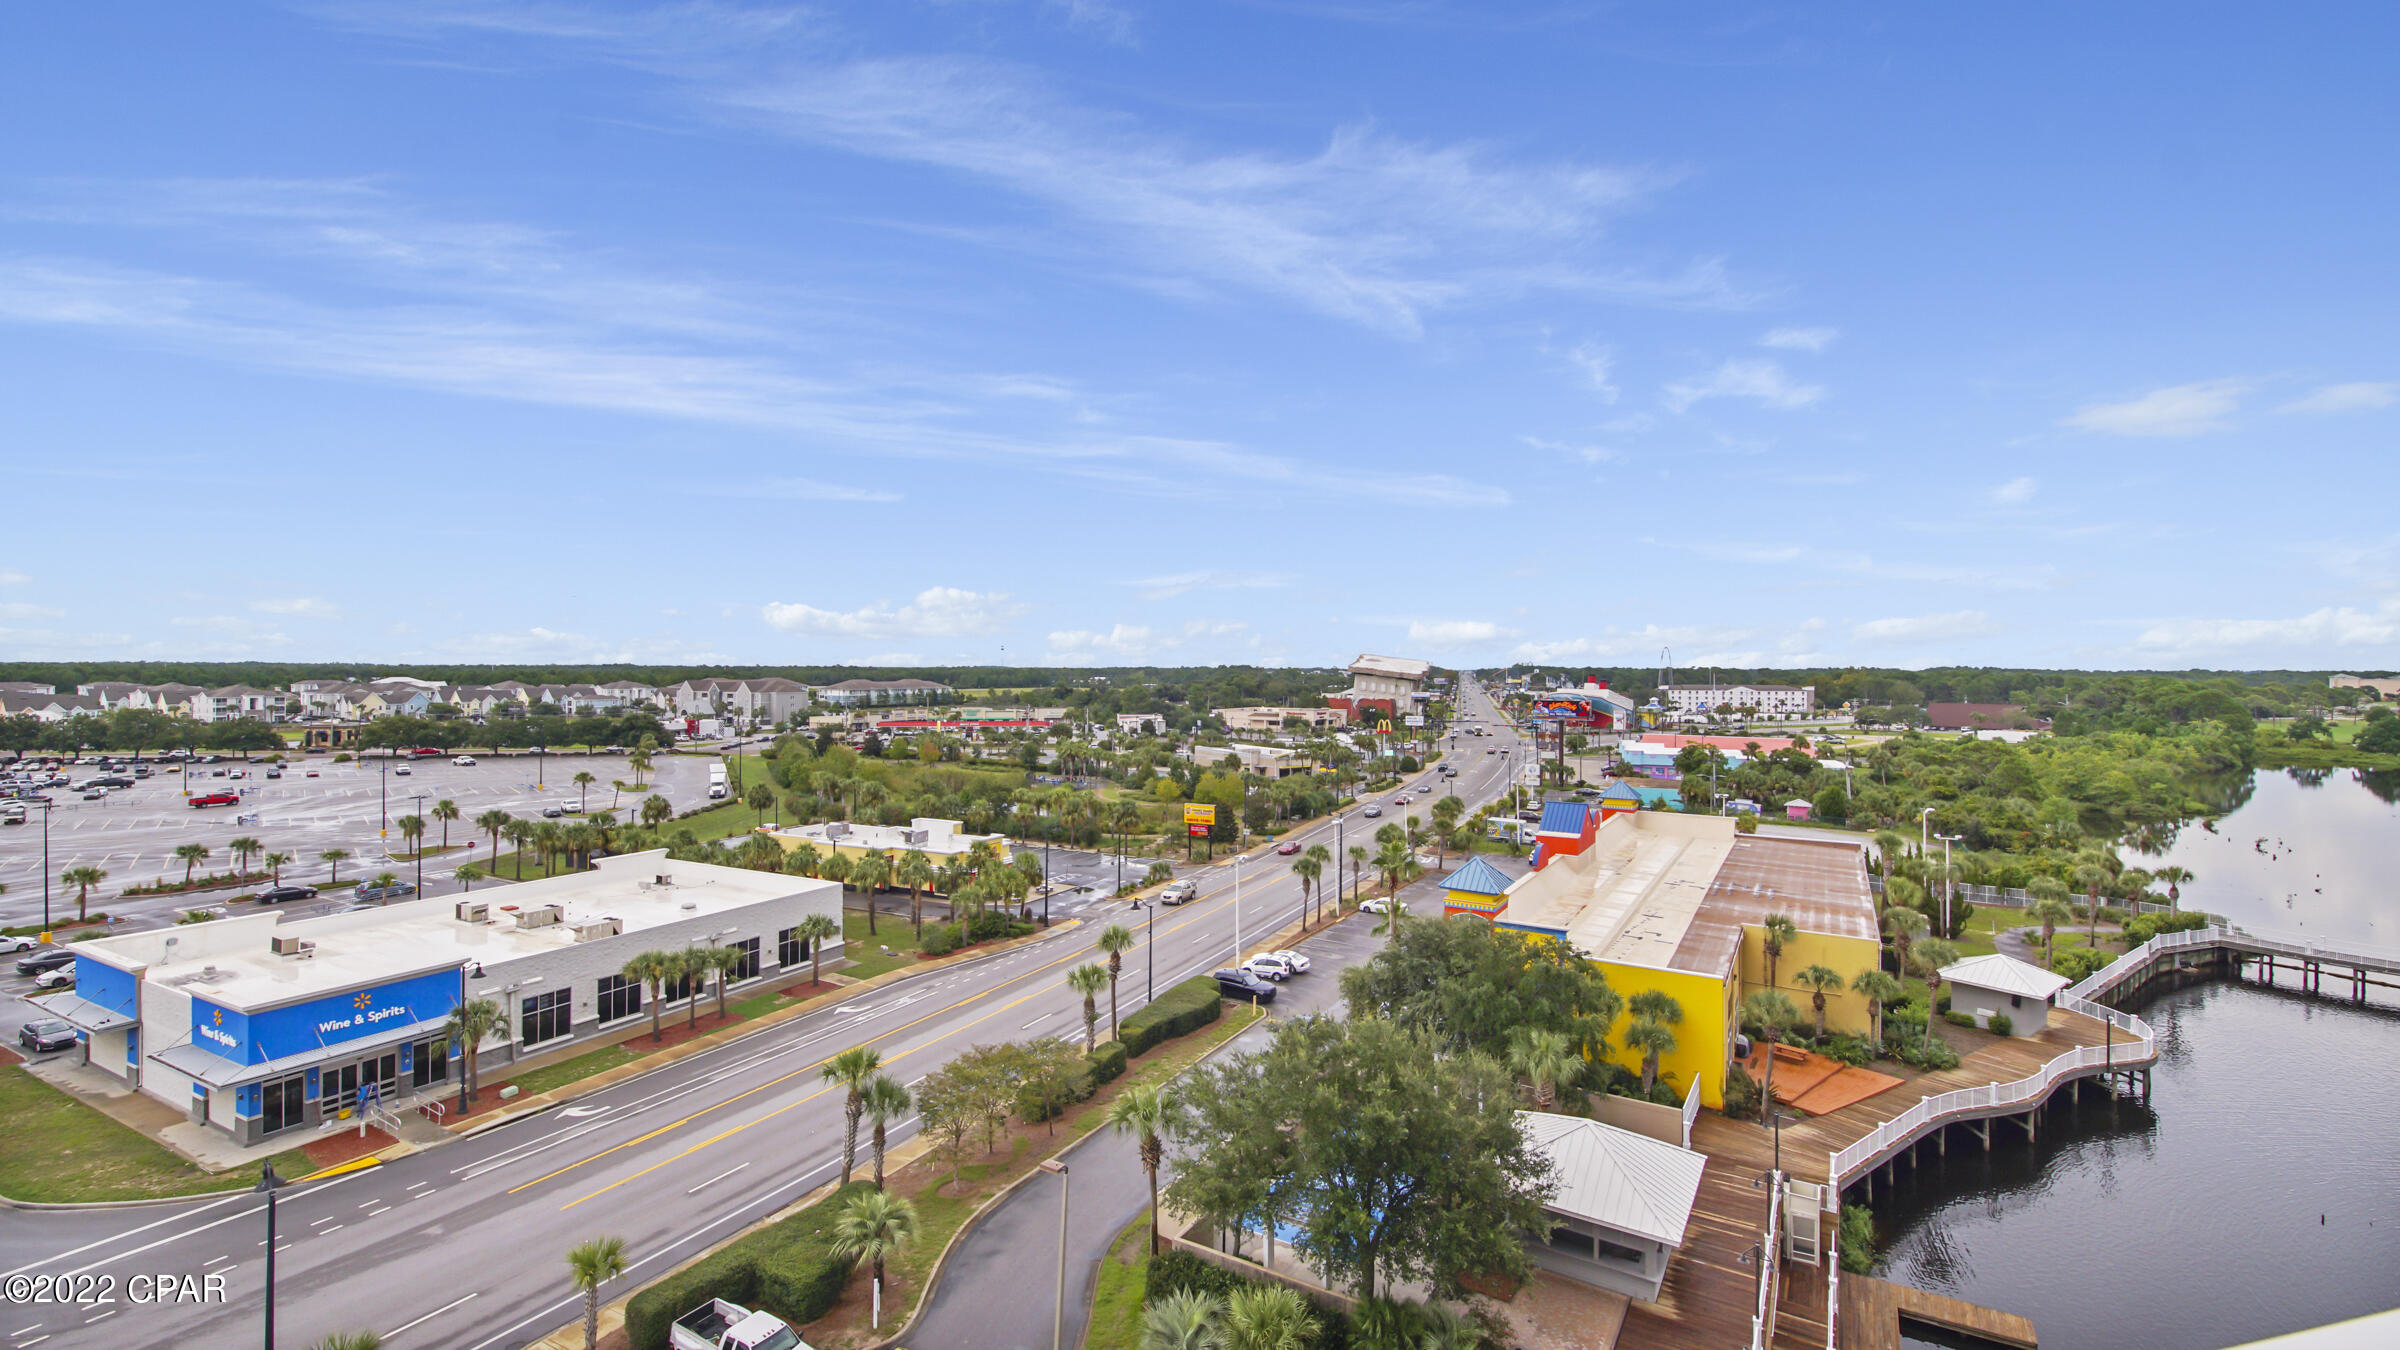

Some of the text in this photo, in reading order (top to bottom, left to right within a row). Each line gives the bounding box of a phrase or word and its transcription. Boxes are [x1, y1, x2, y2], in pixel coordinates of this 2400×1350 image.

[319, 1006, 406, 1033] Wine & Spirits
